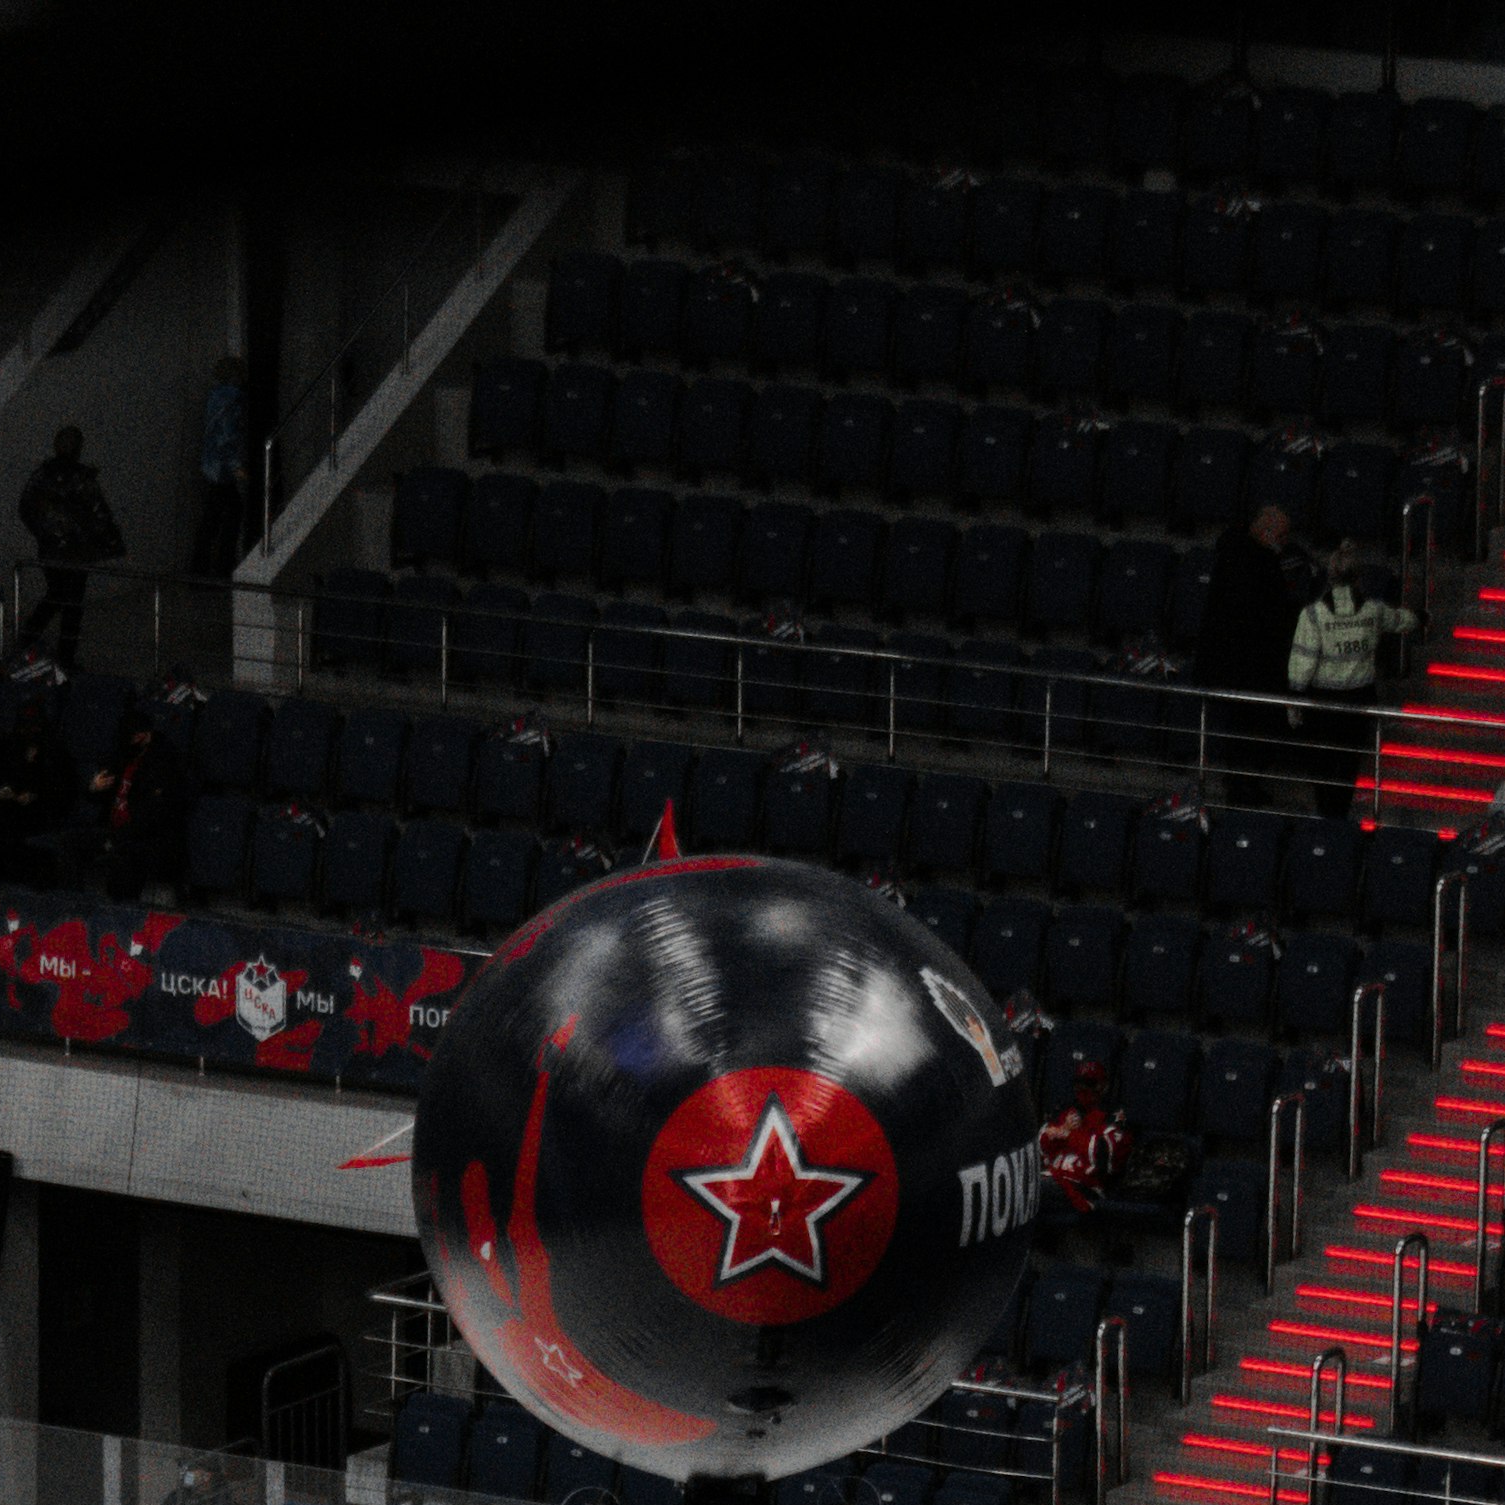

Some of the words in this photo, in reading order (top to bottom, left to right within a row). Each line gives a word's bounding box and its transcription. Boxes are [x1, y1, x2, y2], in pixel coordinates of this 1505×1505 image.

[39, 953, 77, 979] МЫ
[160, 970, 228, 1000] ЦСКА!
[296, 987, 334, 1015] МЫ
